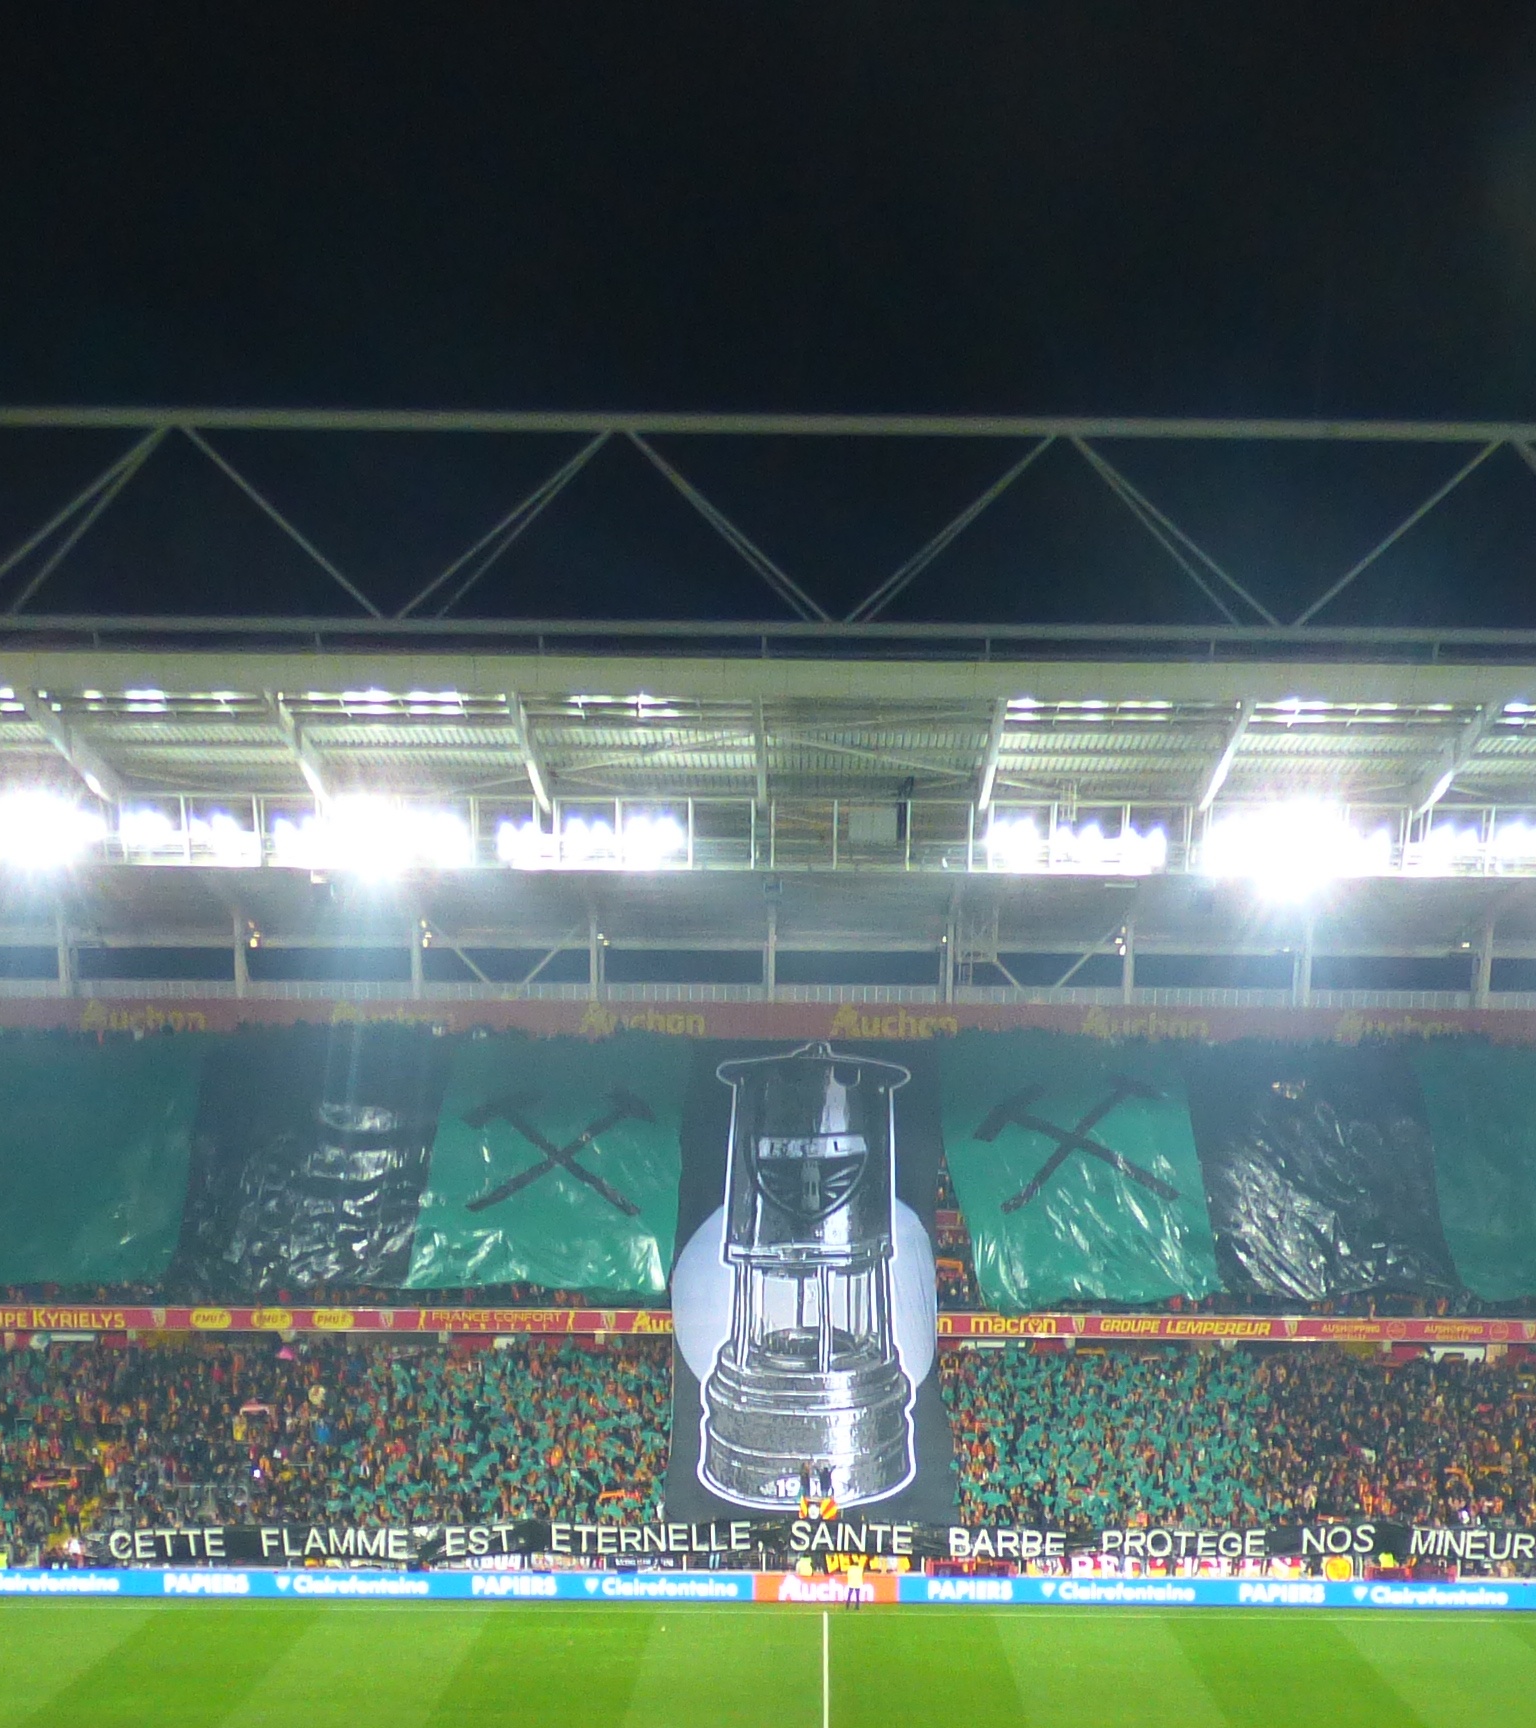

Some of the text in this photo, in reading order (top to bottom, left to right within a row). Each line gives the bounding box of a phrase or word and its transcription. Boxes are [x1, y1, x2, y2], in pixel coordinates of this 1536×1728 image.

[831, 1004, 957, 1038] Auchan
[32, 1310, 125, 1329] KYRIELYS
[432, 1312, 562, 1323] FRANCE CONFORT
[970, 1317, 1056, 1334] macron
[1100, 1320, 1271, 1335] GROUPE LEMPEREUR
[110, 1527, 226, 1559] CETTE
[260, 1527, 409, 1560] FLAMME
[445, 1525, 514, 1557] EST
[790, 1521, 913, 1555] SAINTE
[948, 1526, 1067, 1558] BARBE
[1101, 1528, 1264, 1557] PROTEGE
[1301, 1524, 1376, 1554] NOS
[164, 1574, 429, 1595] PAPIERS Clairefontaine
[472, 1576, 739, 1597] PAPIERS Clairefontaine
[779, 1575, 874, 1602] Auchn
[928, 1580, 1195, 1601] PAPIERS Clairefontaine
[1239, 1584, 1508, 1605] PAPIERS Clairefontaine
